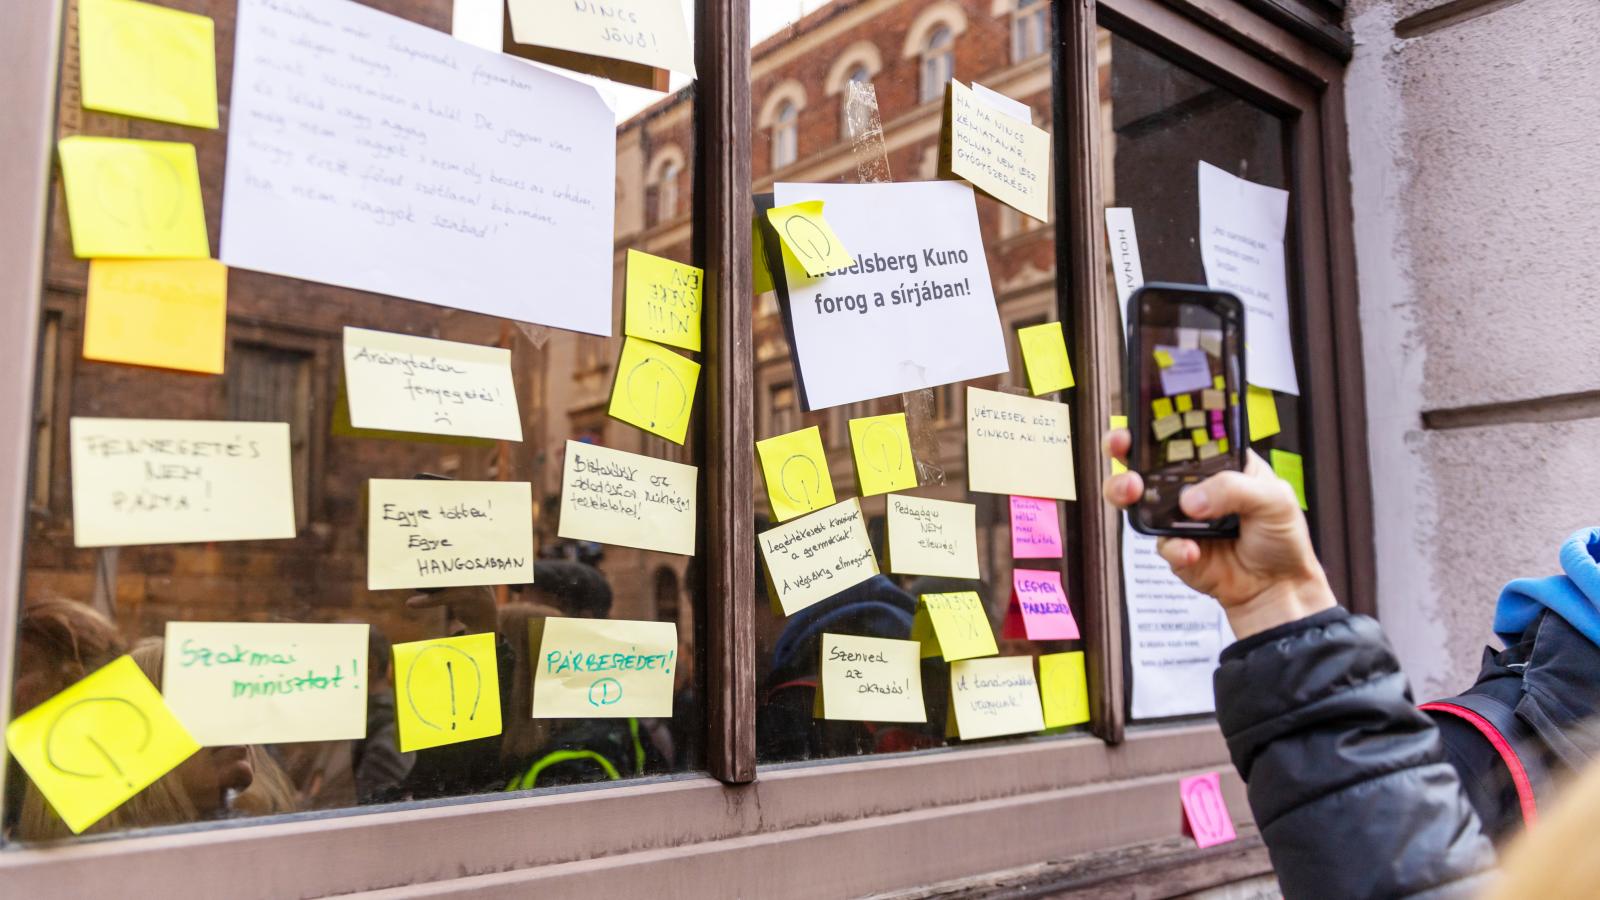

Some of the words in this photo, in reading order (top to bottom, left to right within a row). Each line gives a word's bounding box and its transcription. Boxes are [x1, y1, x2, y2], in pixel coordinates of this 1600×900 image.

[574, 1, 638, 24] NINCS
[956, 92, 971, 110] HA
[976, 107, 991, 122] MA
[994, 118, 1026, 145] NINCS
[921, 247, 970, 269] Kuno
[814, 292, 868, 316] forog
[873, 291, 886, 309] a
[890, 277, 972, 308] sírjában!
[353, 347, 467, 376] Aránytalan
[976, 427, 1016, 442] CINKOS
[80, 433, 261, 459] FENYEGETÉS
[143, 459, 202, 481] NEM
[416, 556, 525, 578] HANGOSABBAN
[791, 552, 801, 561] a
[782, 578, 792, 596] A
[1017, 579, 1058, 594] LEGYEN
[180, 638, 299, 668] Szakmai
[546, 645, 676, 675] PÁRBESZÉDET!
[828, 645, 890, 665] Szenved
[844, 668, 864, 680] az
[856, 677, 912, 701] oktatás!
